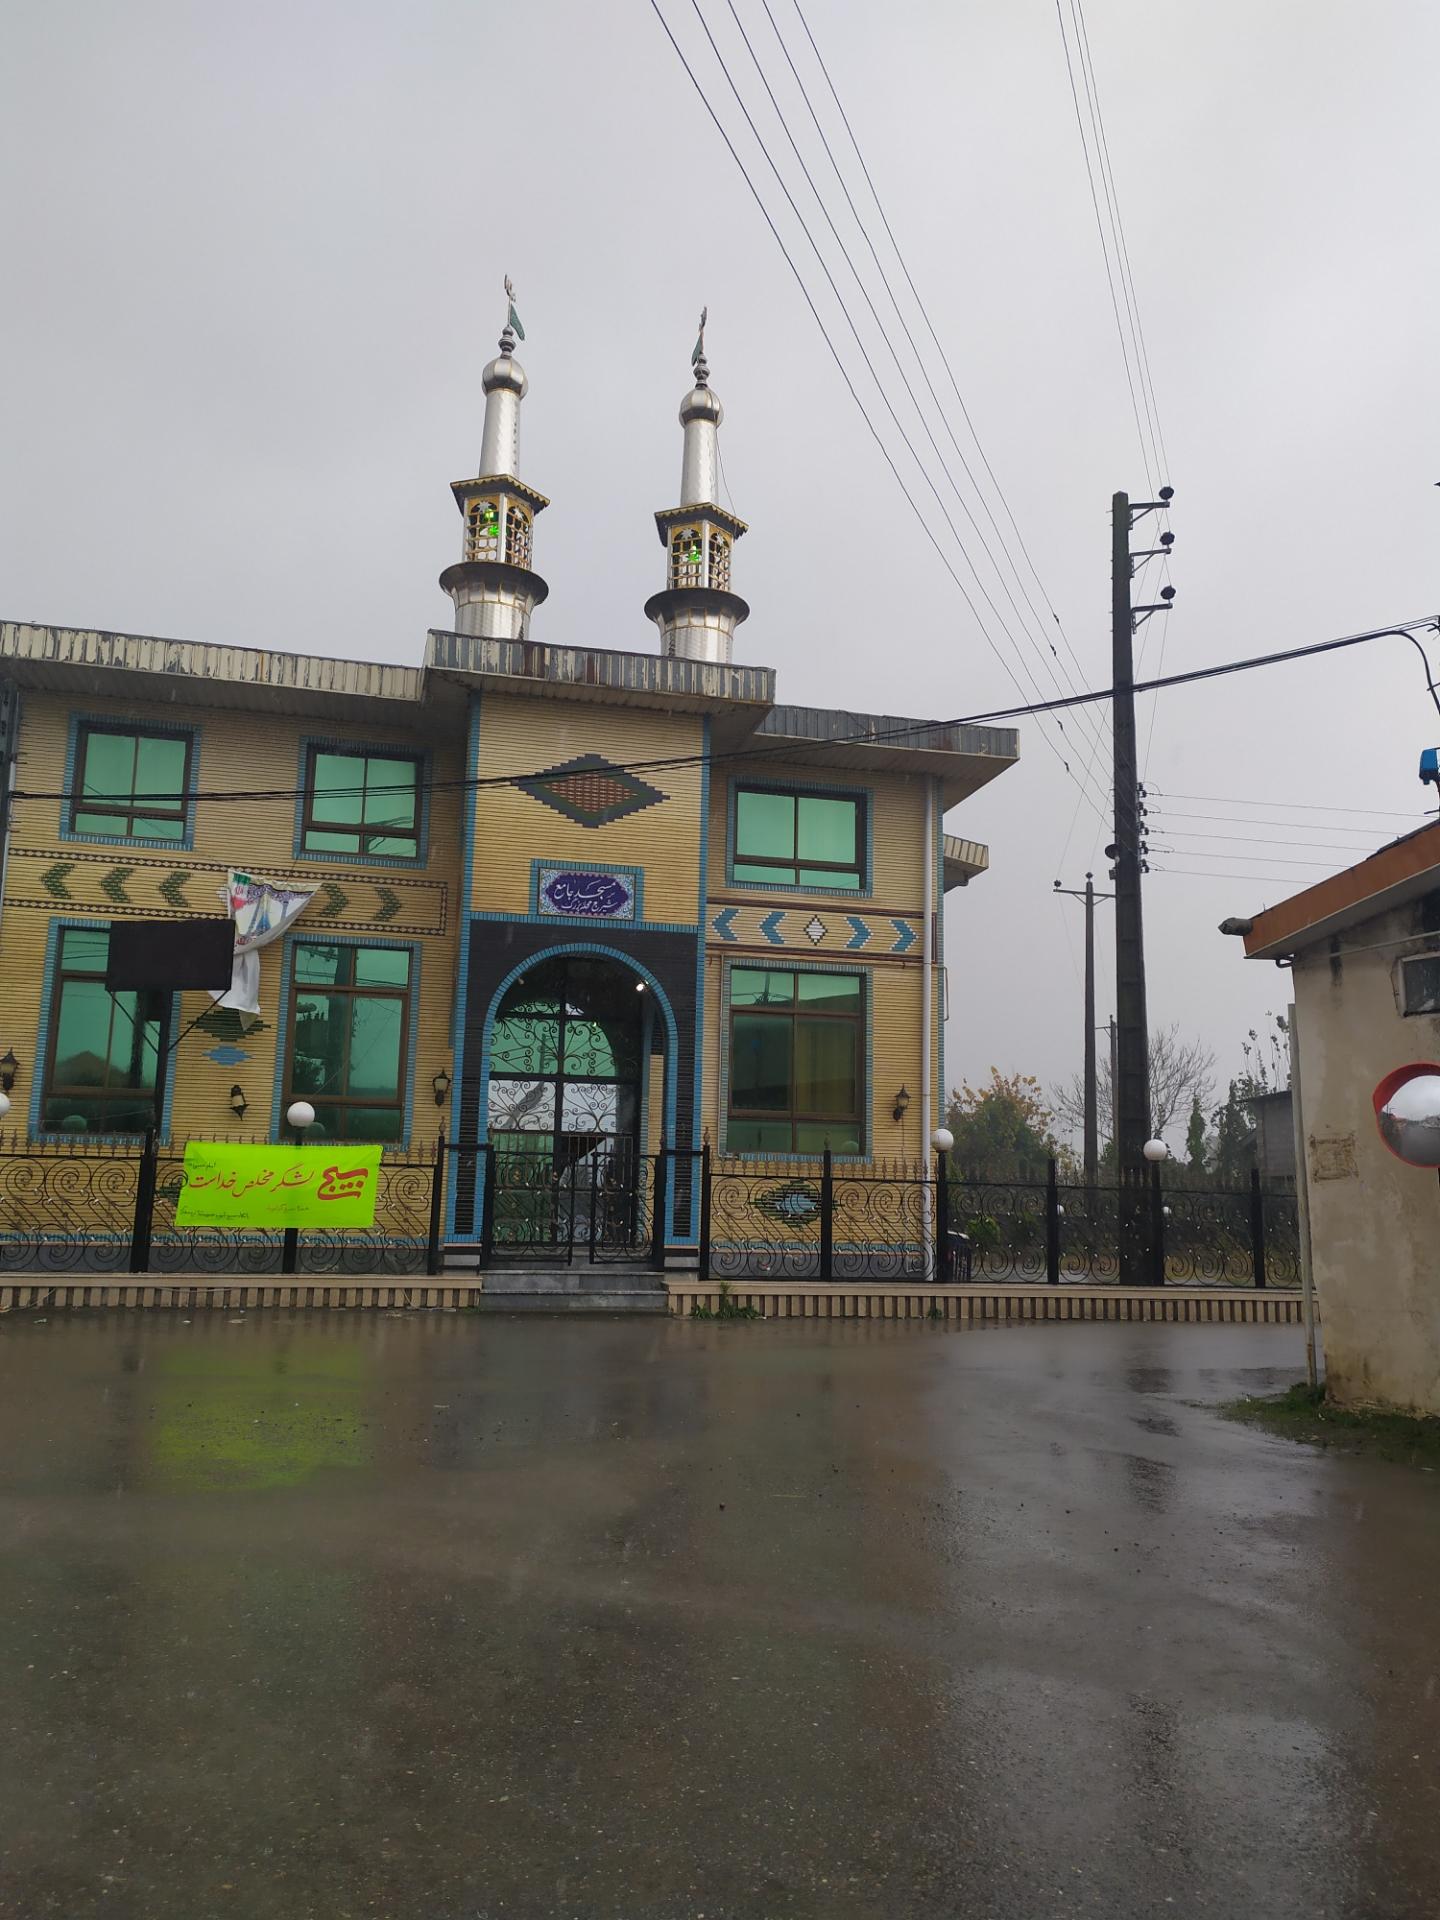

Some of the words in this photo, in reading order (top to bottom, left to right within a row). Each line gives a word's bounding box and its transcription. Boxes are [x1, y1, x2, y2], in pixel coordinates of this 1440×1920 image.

[553, 883, 574, 900] جامع
[574, 880, 616, 900] مسجد
[232, 1169, 274, 1197] مخلص
[270, 1164, 314, 1192] لشکر
[317, 1166, 368, 1200] بسیج
